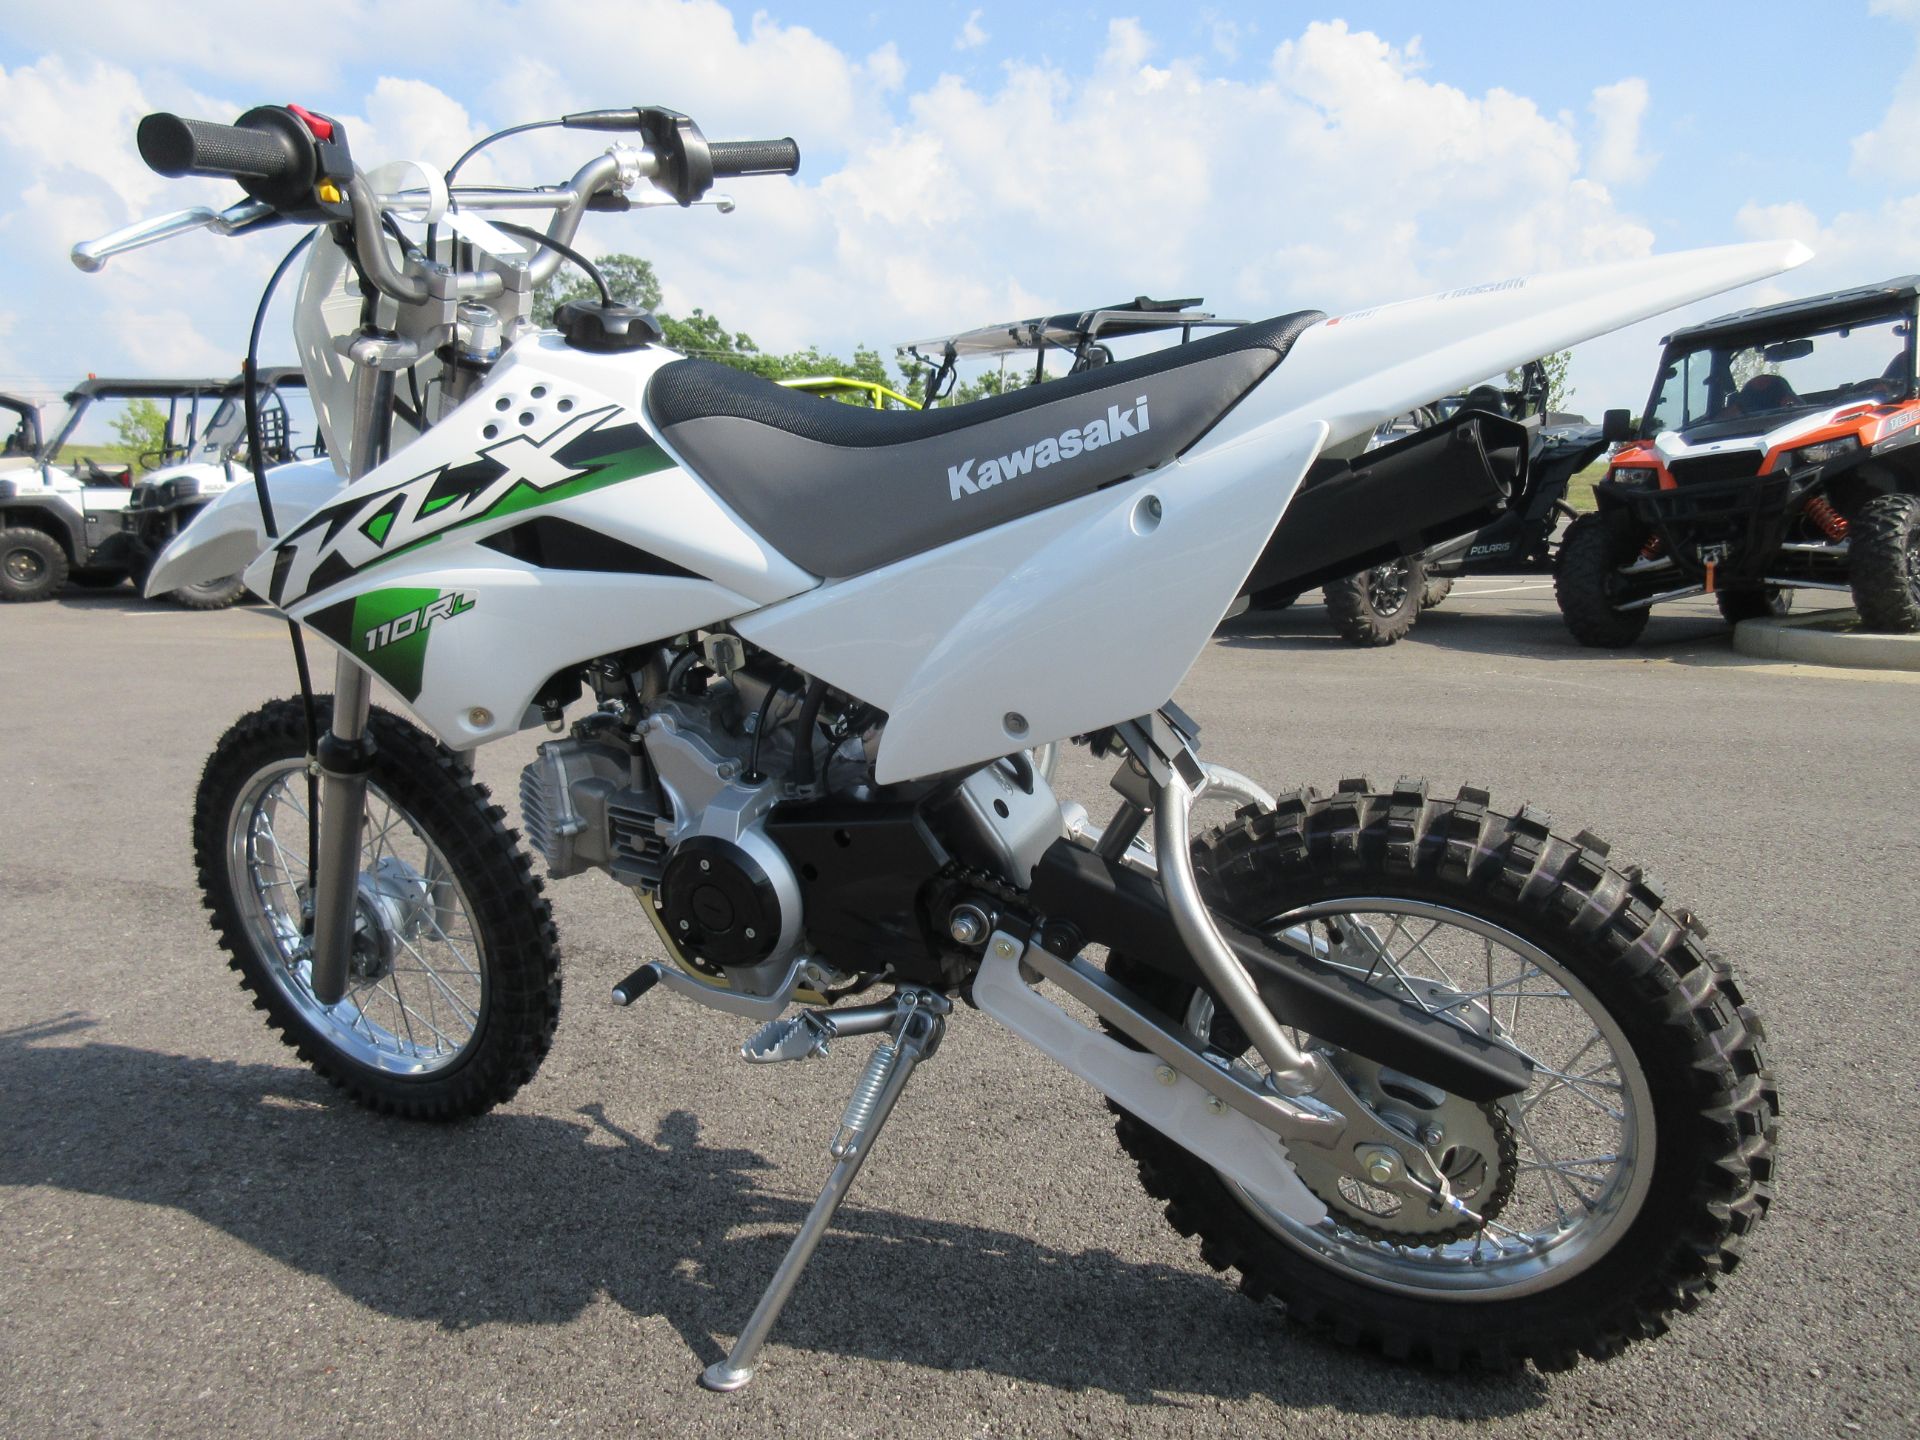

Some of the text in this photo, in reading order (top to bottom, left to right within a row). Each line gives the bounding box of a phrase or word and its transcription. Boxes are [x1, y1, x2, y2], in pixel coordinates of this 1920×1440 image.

[947, 394, 1150, 501] Kawasaki
[270, 403, 626, 610] KLX
[1470, 542, 1511, 555] POLARIS
